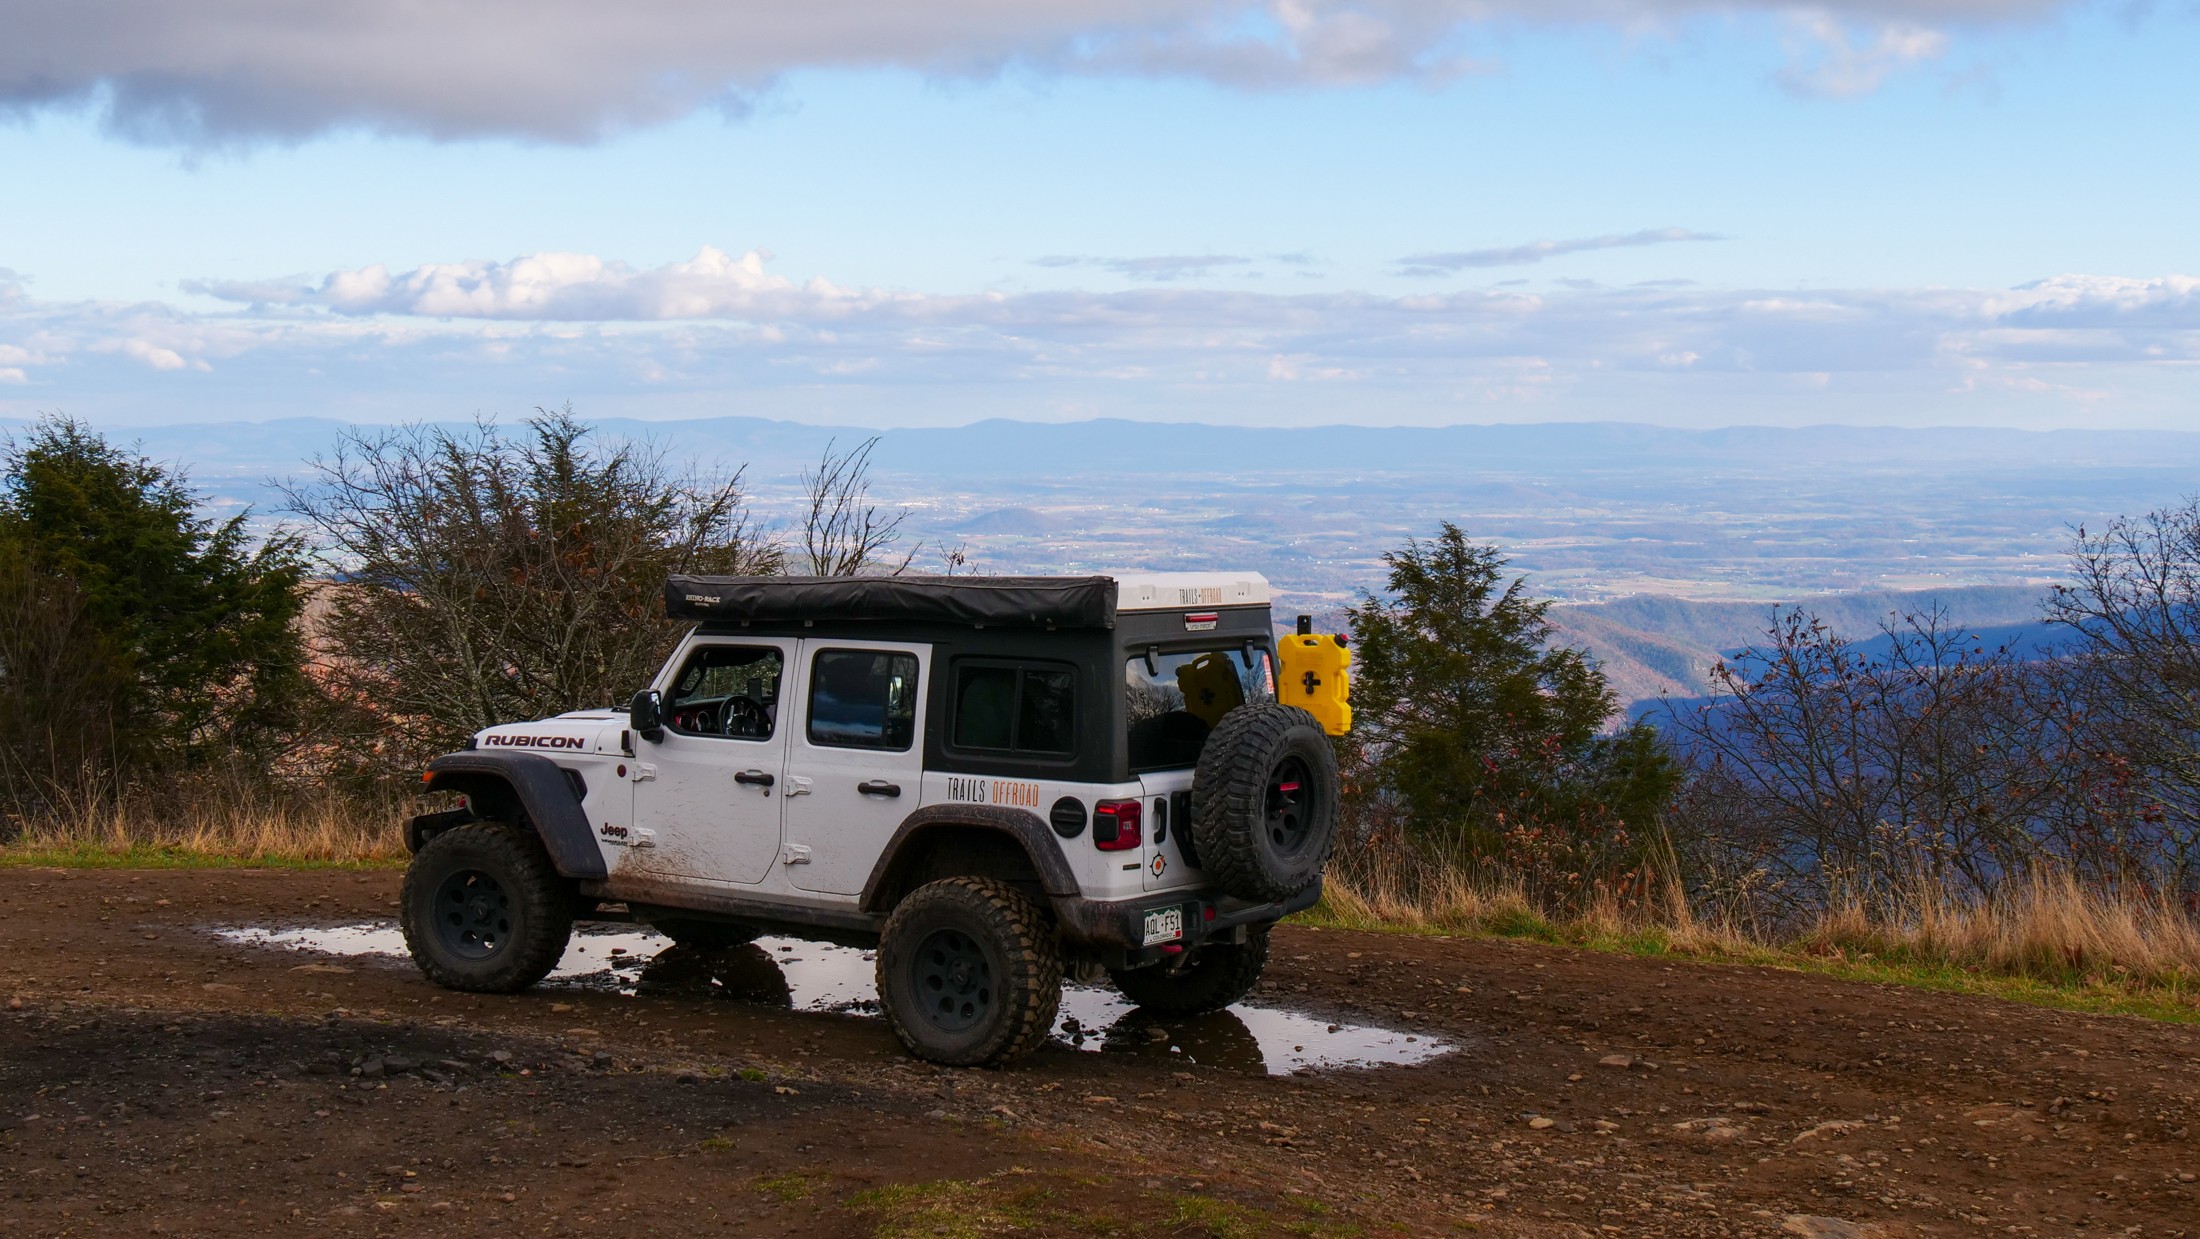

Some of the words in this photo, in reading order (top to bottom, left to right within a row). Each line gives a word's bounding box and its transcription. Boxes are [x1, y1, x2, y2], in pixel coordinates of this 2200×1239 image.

[1179, 588, 1197, 604] TRAILS
[484, 735, 585, 749] RUBICON
[948, 777, 985, 803] TRAILS
[992, 781, 1039, 807] OFFROAD
[600, 821, 628, 840] Jeep
